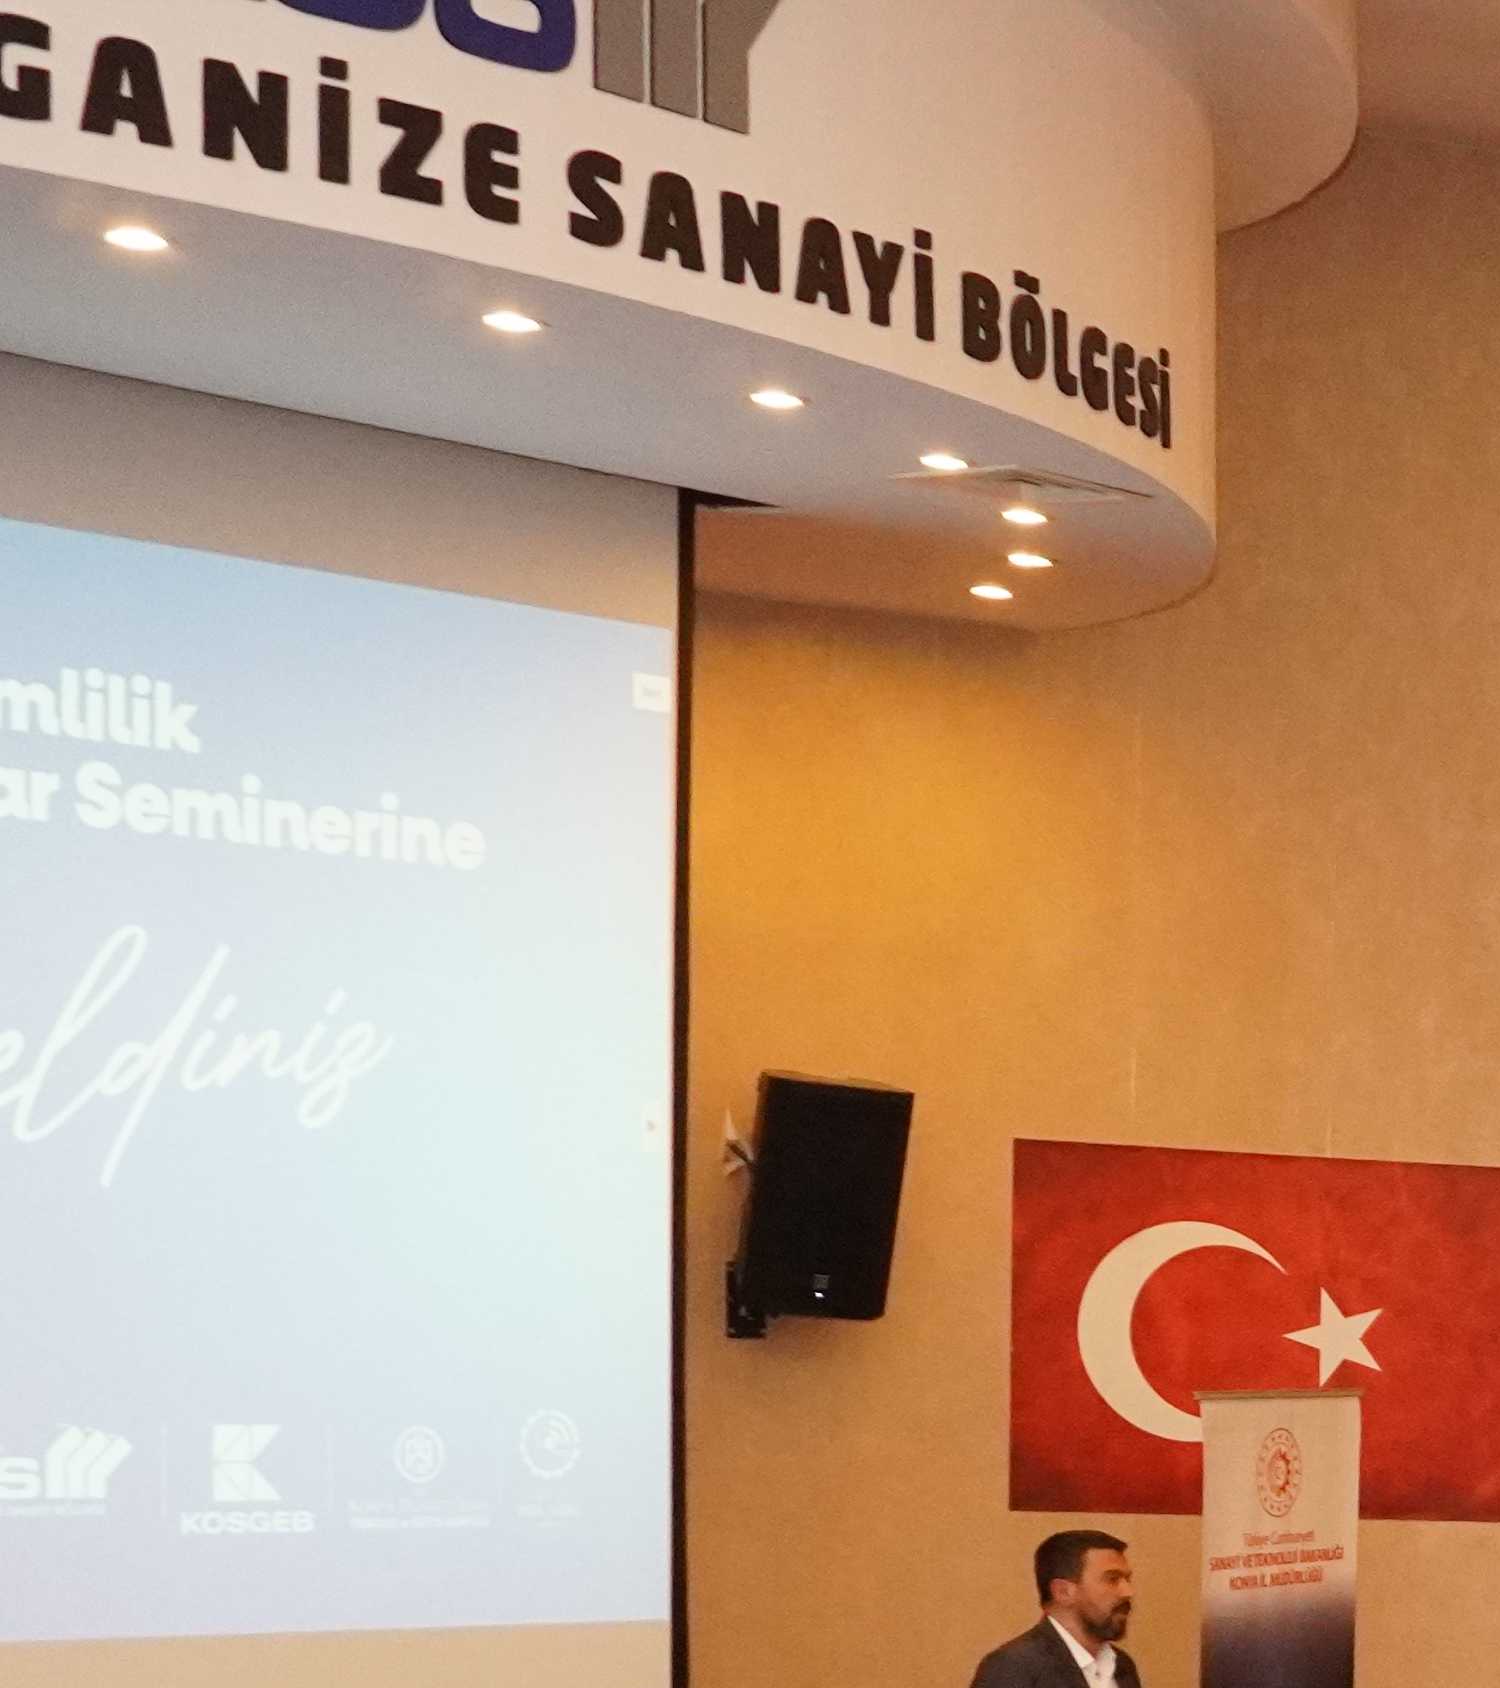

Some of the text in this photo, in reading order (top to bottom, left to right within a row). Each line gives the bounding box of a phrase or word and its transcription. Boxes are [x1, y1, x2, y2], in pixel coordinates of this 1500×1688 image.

[567, 149, 936, 342] SANAYİ
[961, 269, 1172, 450] BÖLGESİ
[74, 760, 487, 871] Seminerine
[180, 1510, 314, 1536] KOSGEB
